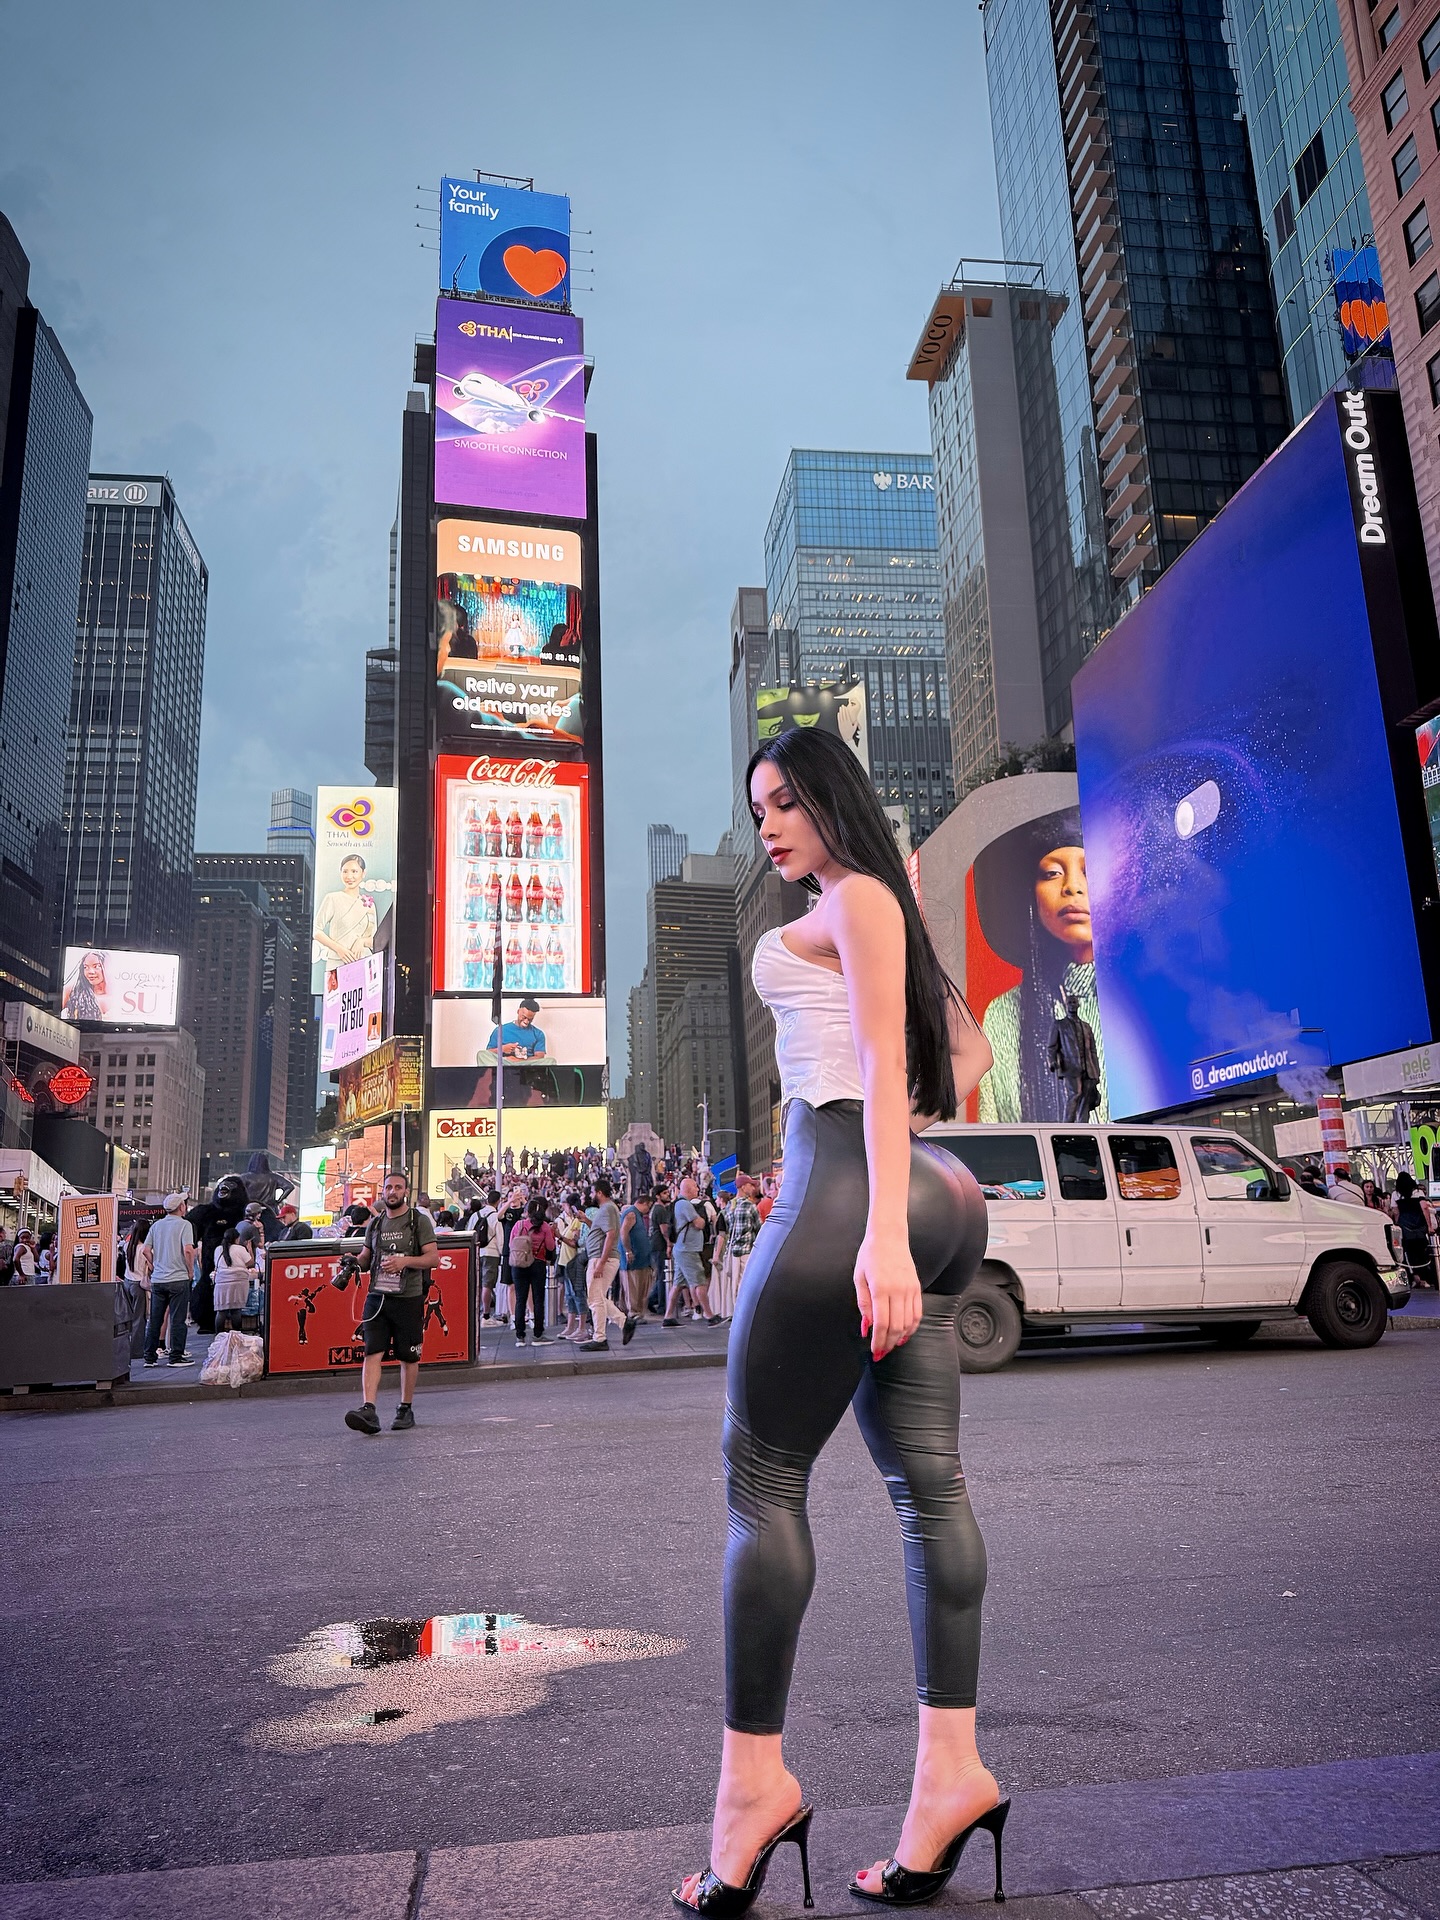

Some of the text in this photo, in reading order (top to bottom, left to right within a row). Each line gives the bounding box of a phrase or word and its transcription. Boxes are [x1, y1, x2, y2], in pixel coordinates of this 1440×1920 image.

[448, 183, 487, 202] Your
[448, 198, 500, 221] family
[453, 439, 568, 461] SMOOTH CONNECTION
[896, 474, 935, 490] BAR
[1356, 453, 1386, 544] Dream
[457, 535, 564, 562] SAMSUNG
[521, 586, 558, 600] SHOW
[465, 676, 559, 700] Relive your
[452, 695, 572, 718] old memories
[466, 755, 560, 788] Coca-Cola
[341, 987, 363, 1012] SHOP
[34, 1022, 53, 1040] HYATT
[339, 1007, 364, 1034] IN BIO
[437, 1119, 471, 1137] Cat
[284, 1263, 324, 1280] OFF.
[331, 1349, 352, 1363] MJ
